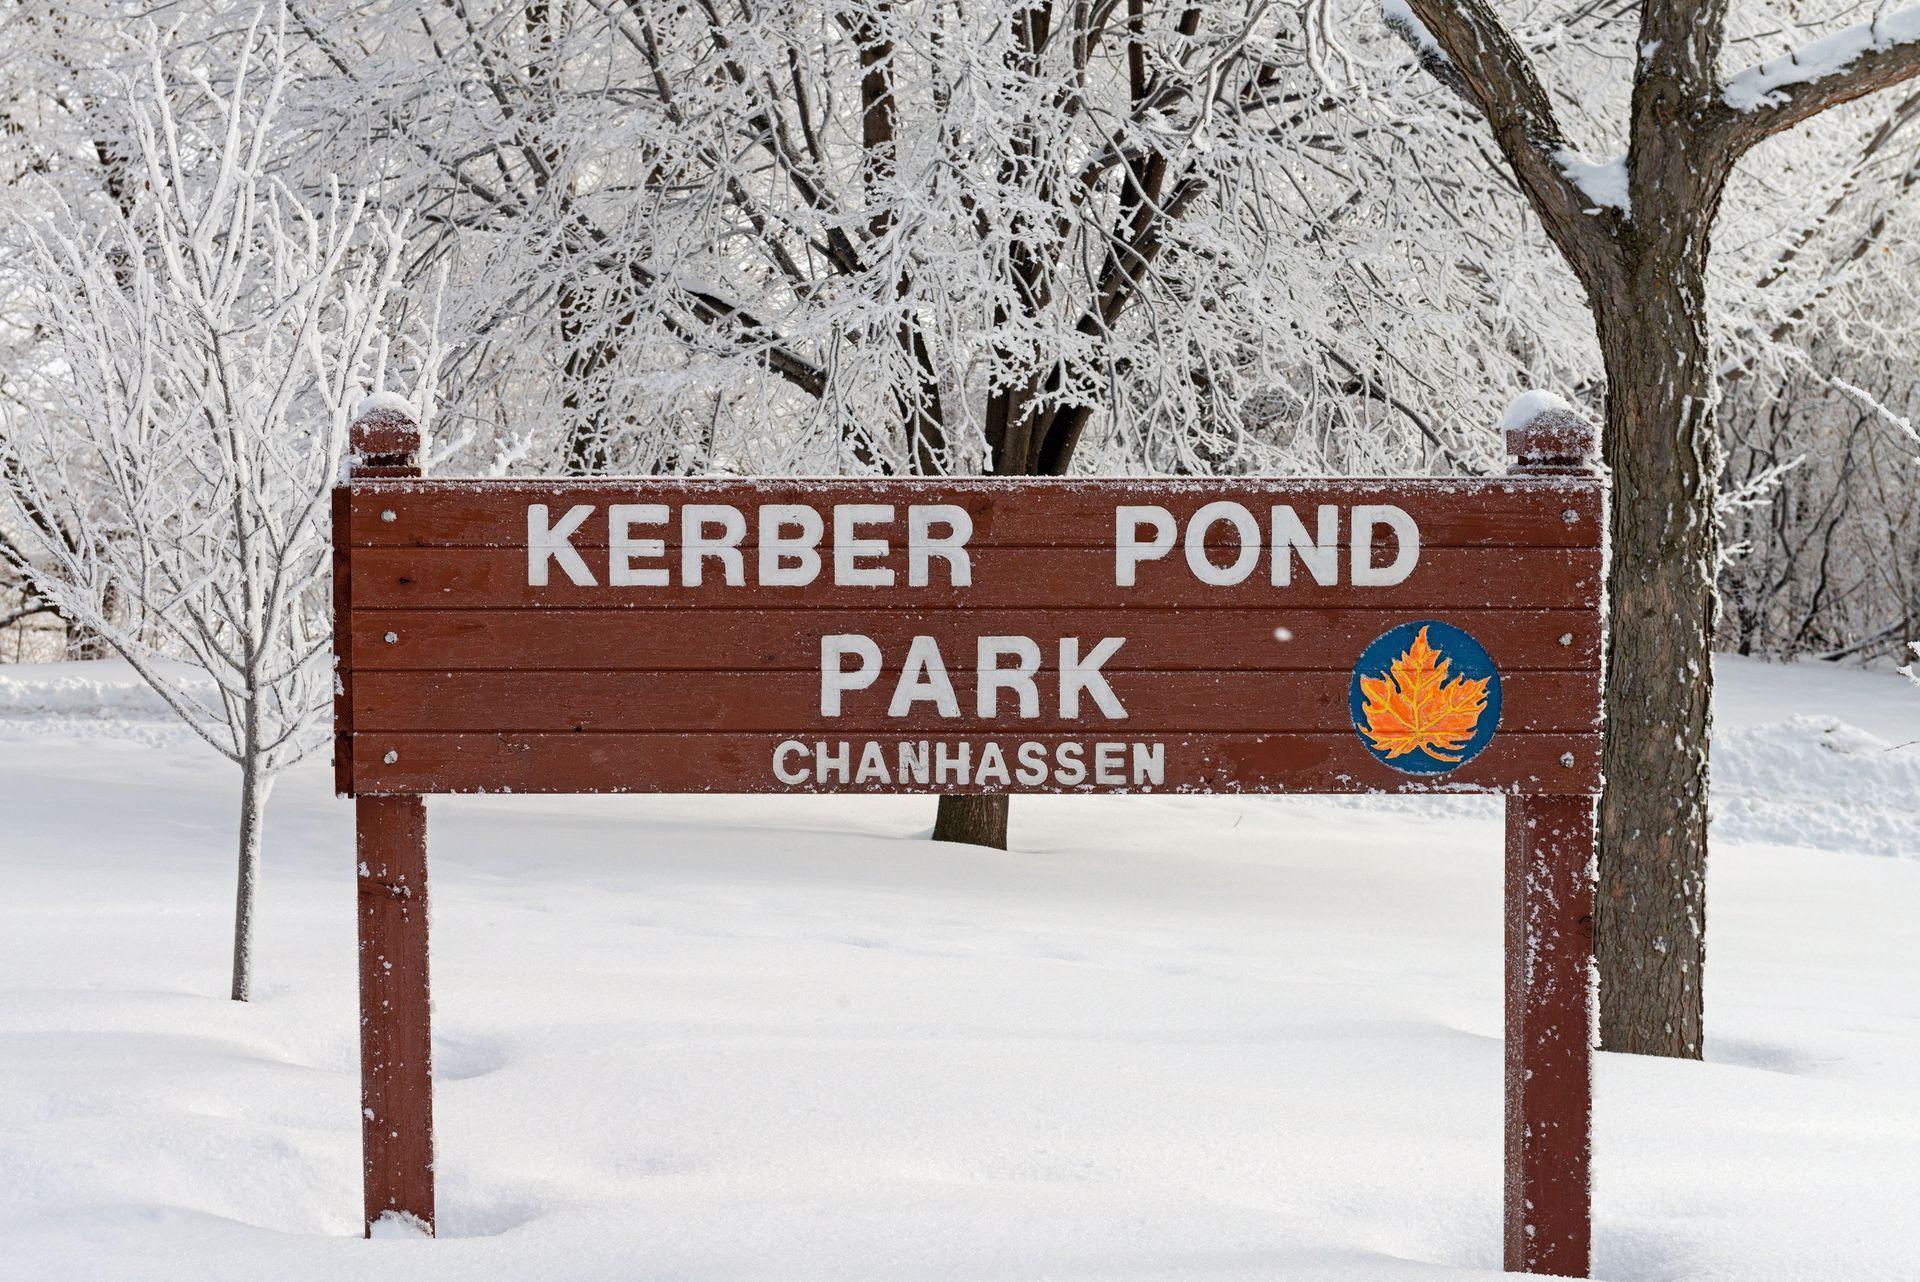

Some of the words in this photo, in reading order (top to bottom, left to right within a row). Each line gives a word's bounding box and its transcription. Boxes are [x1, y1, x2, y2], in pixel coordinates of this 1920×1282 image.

[527, 503, 973, 588] KERBER
[1115, 500, 1423, 588] POND
[820, 633, 1129, 720] PARK
[772, 739, 1165, 787] CHANHASSEN
